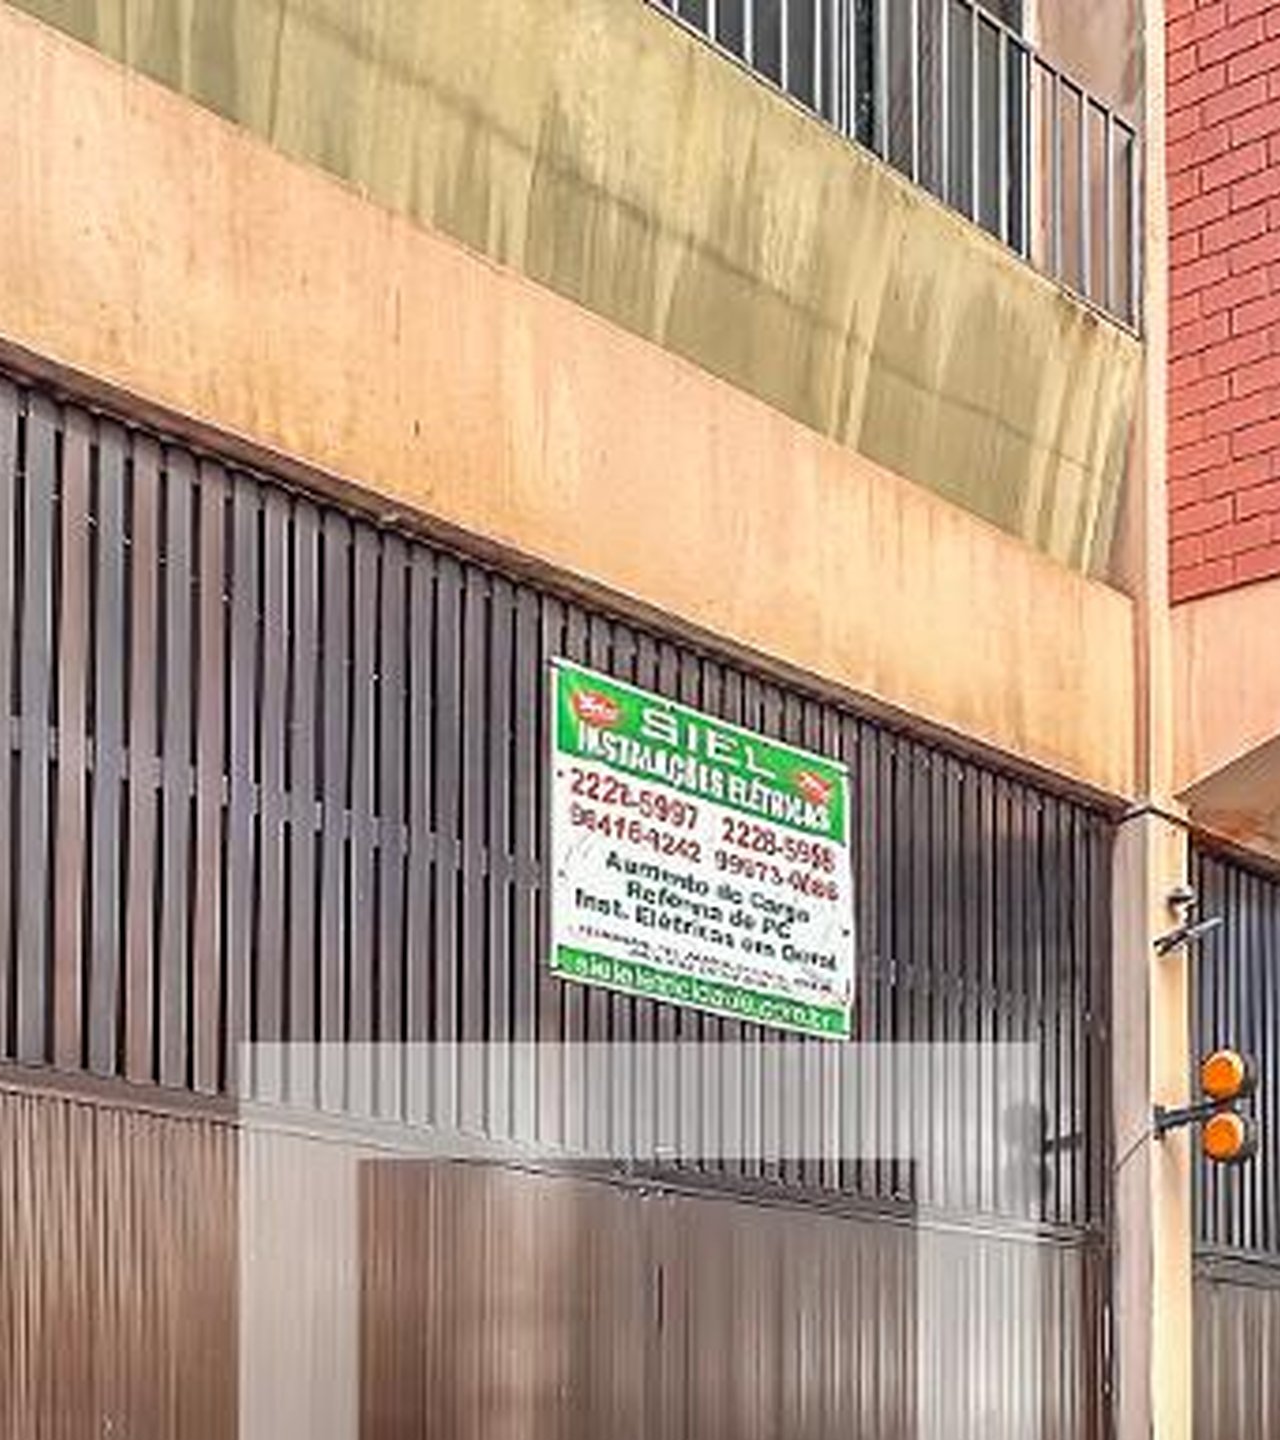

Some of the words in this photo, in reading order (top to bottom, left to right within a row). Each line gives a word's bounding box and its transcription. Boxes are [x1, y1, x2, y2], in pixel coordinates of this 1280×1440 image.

[640, 703, 775, 780] SIEL
[606, 848, 708, 896] Aumento
[729, 907, 756, 931] de
[763, 916, 791, 940] PC
